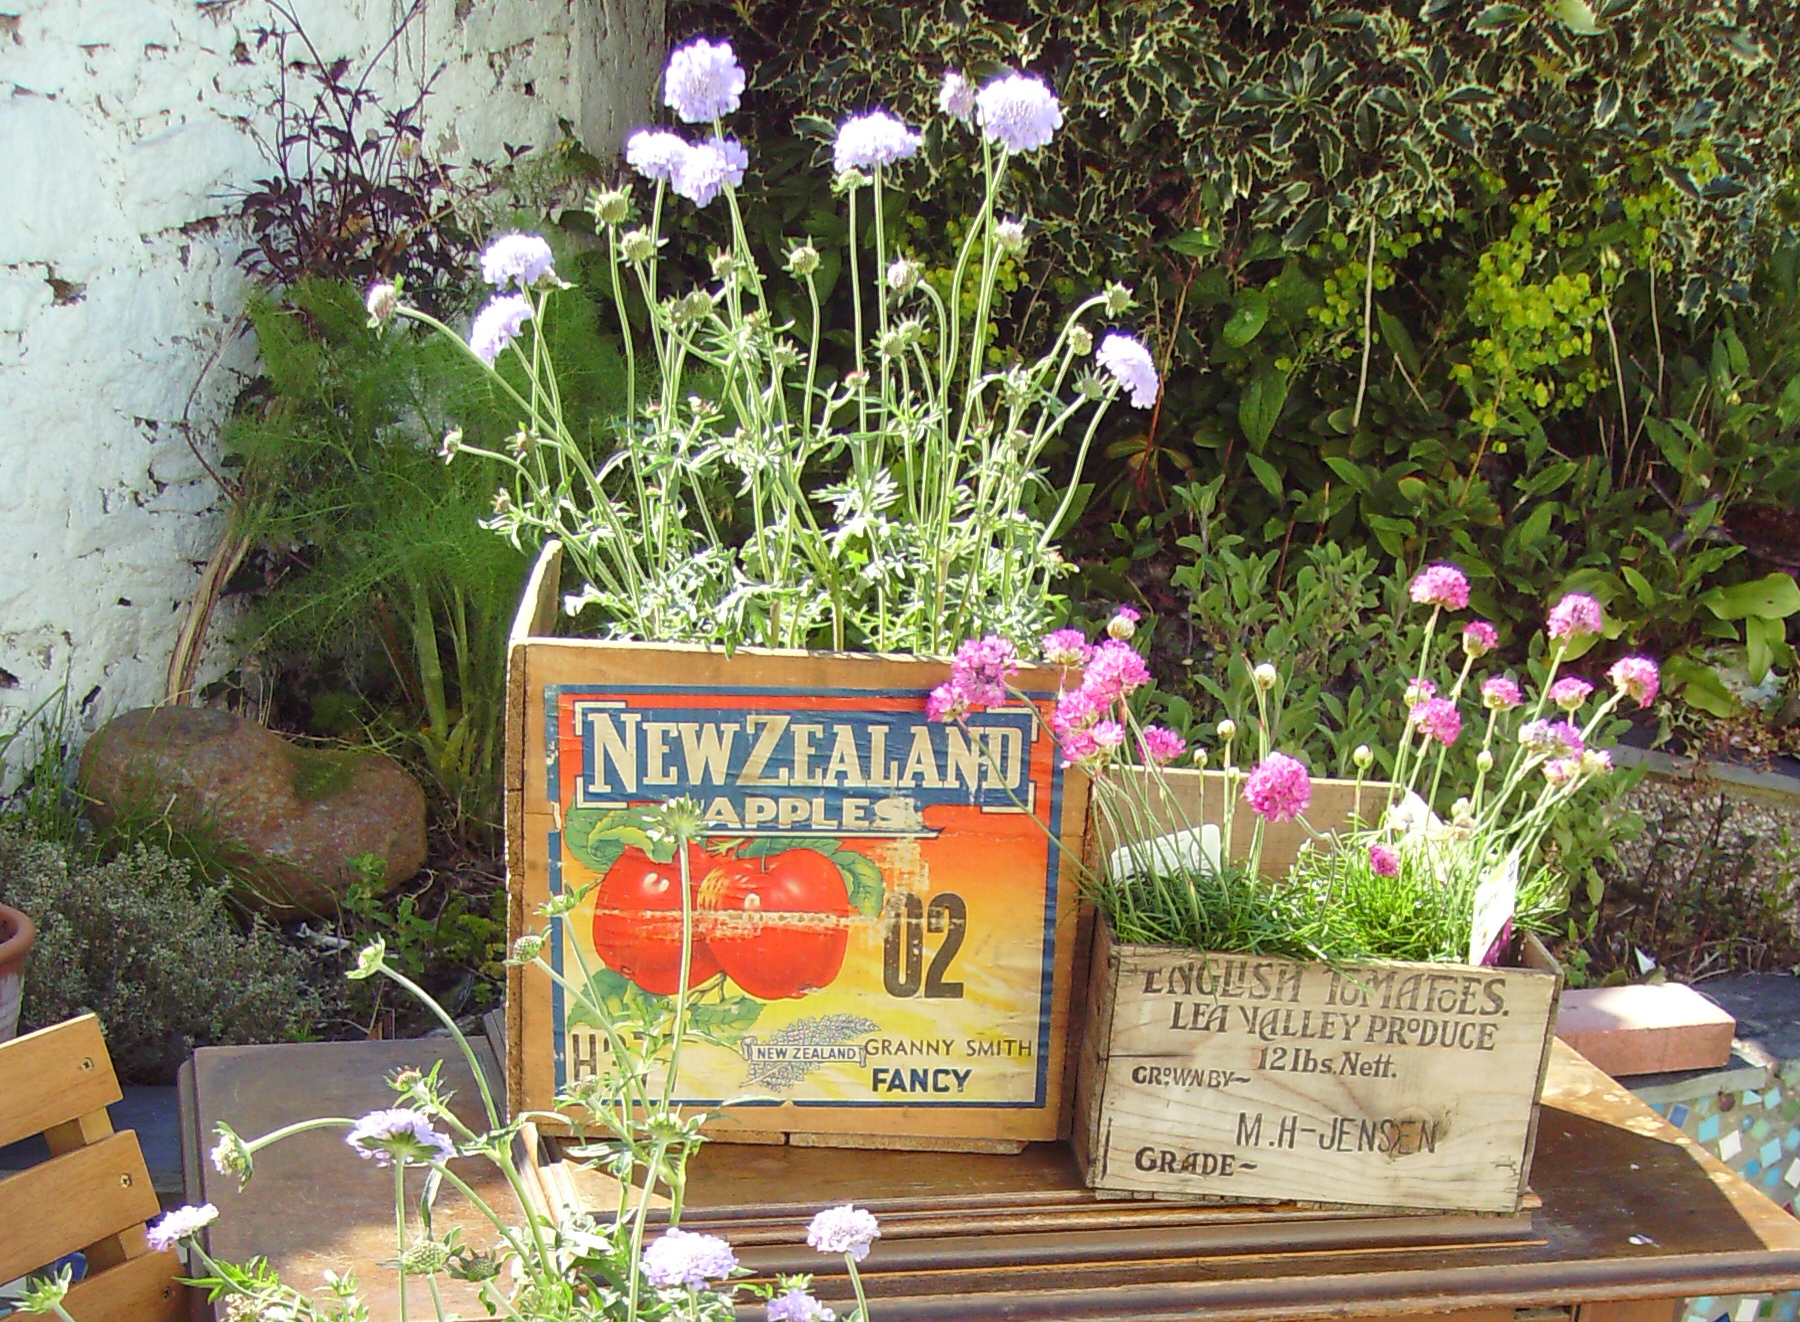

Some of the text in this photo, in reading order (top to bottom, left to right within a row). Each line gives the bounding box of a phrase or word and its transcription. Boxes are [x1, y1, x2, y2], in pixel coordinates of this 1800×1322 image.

[703, 796, 920, 829] APPLES
[1143, 960, 1304, 1003] ENGLISH
[1169, 1001, 1499, 1050] LEA VALLEY PRODUCE
[757, 1047, 857, 1060] NEW ZEALAND
[864, 1039, 1032, 1056] GRANNY SMITH
[872, 1068, 973, 1092] FANCY
